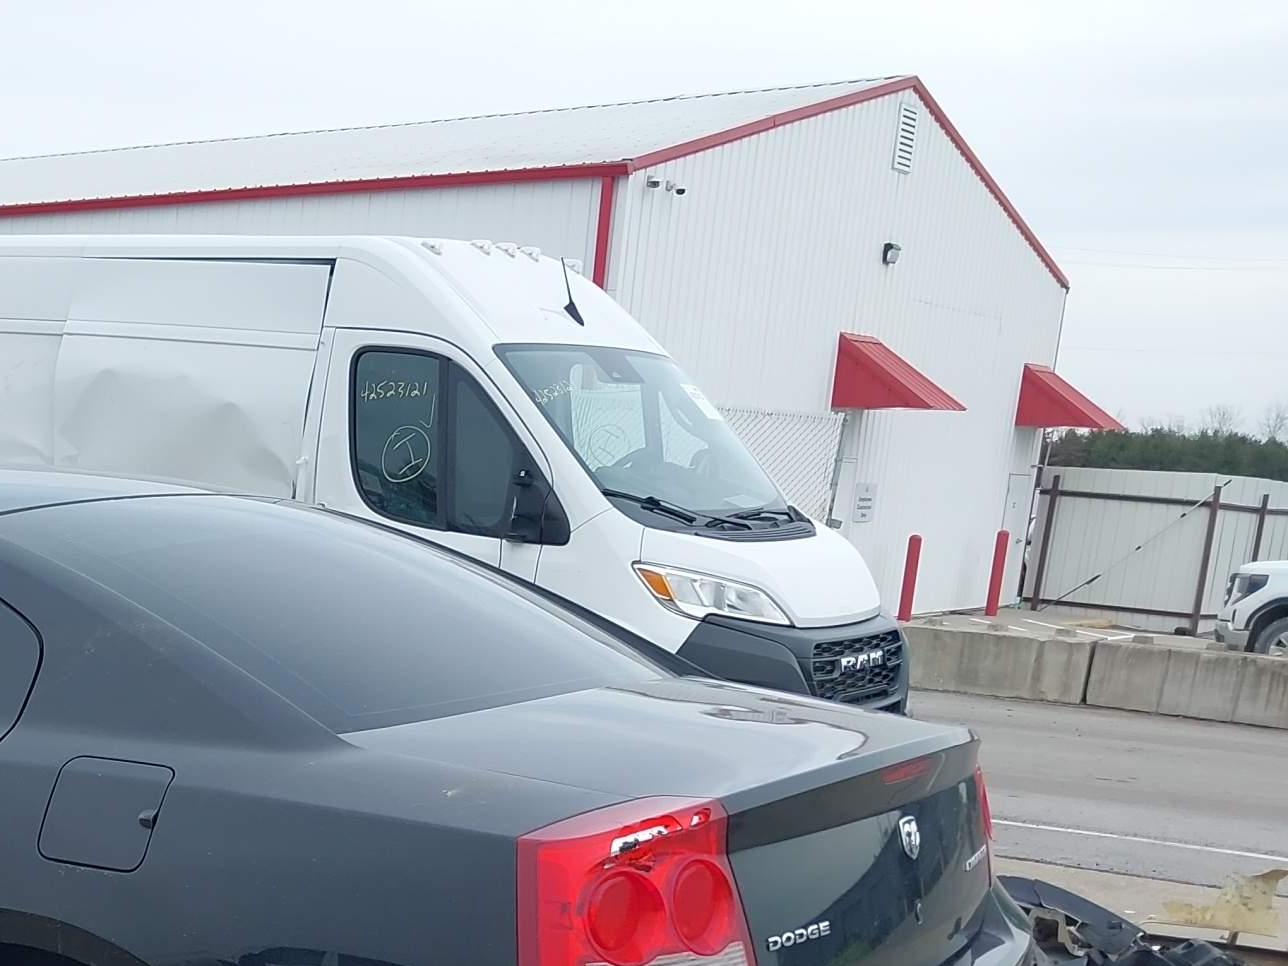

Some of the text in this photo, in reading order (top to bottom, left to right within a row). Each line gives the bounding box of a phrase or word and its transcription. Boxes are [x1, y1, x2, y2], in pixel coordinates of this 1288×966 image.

[360, 381, 429, 403] 42523121
[840, 650, 884, 673] RAM
[767, 920, 832, 951] DODGE
